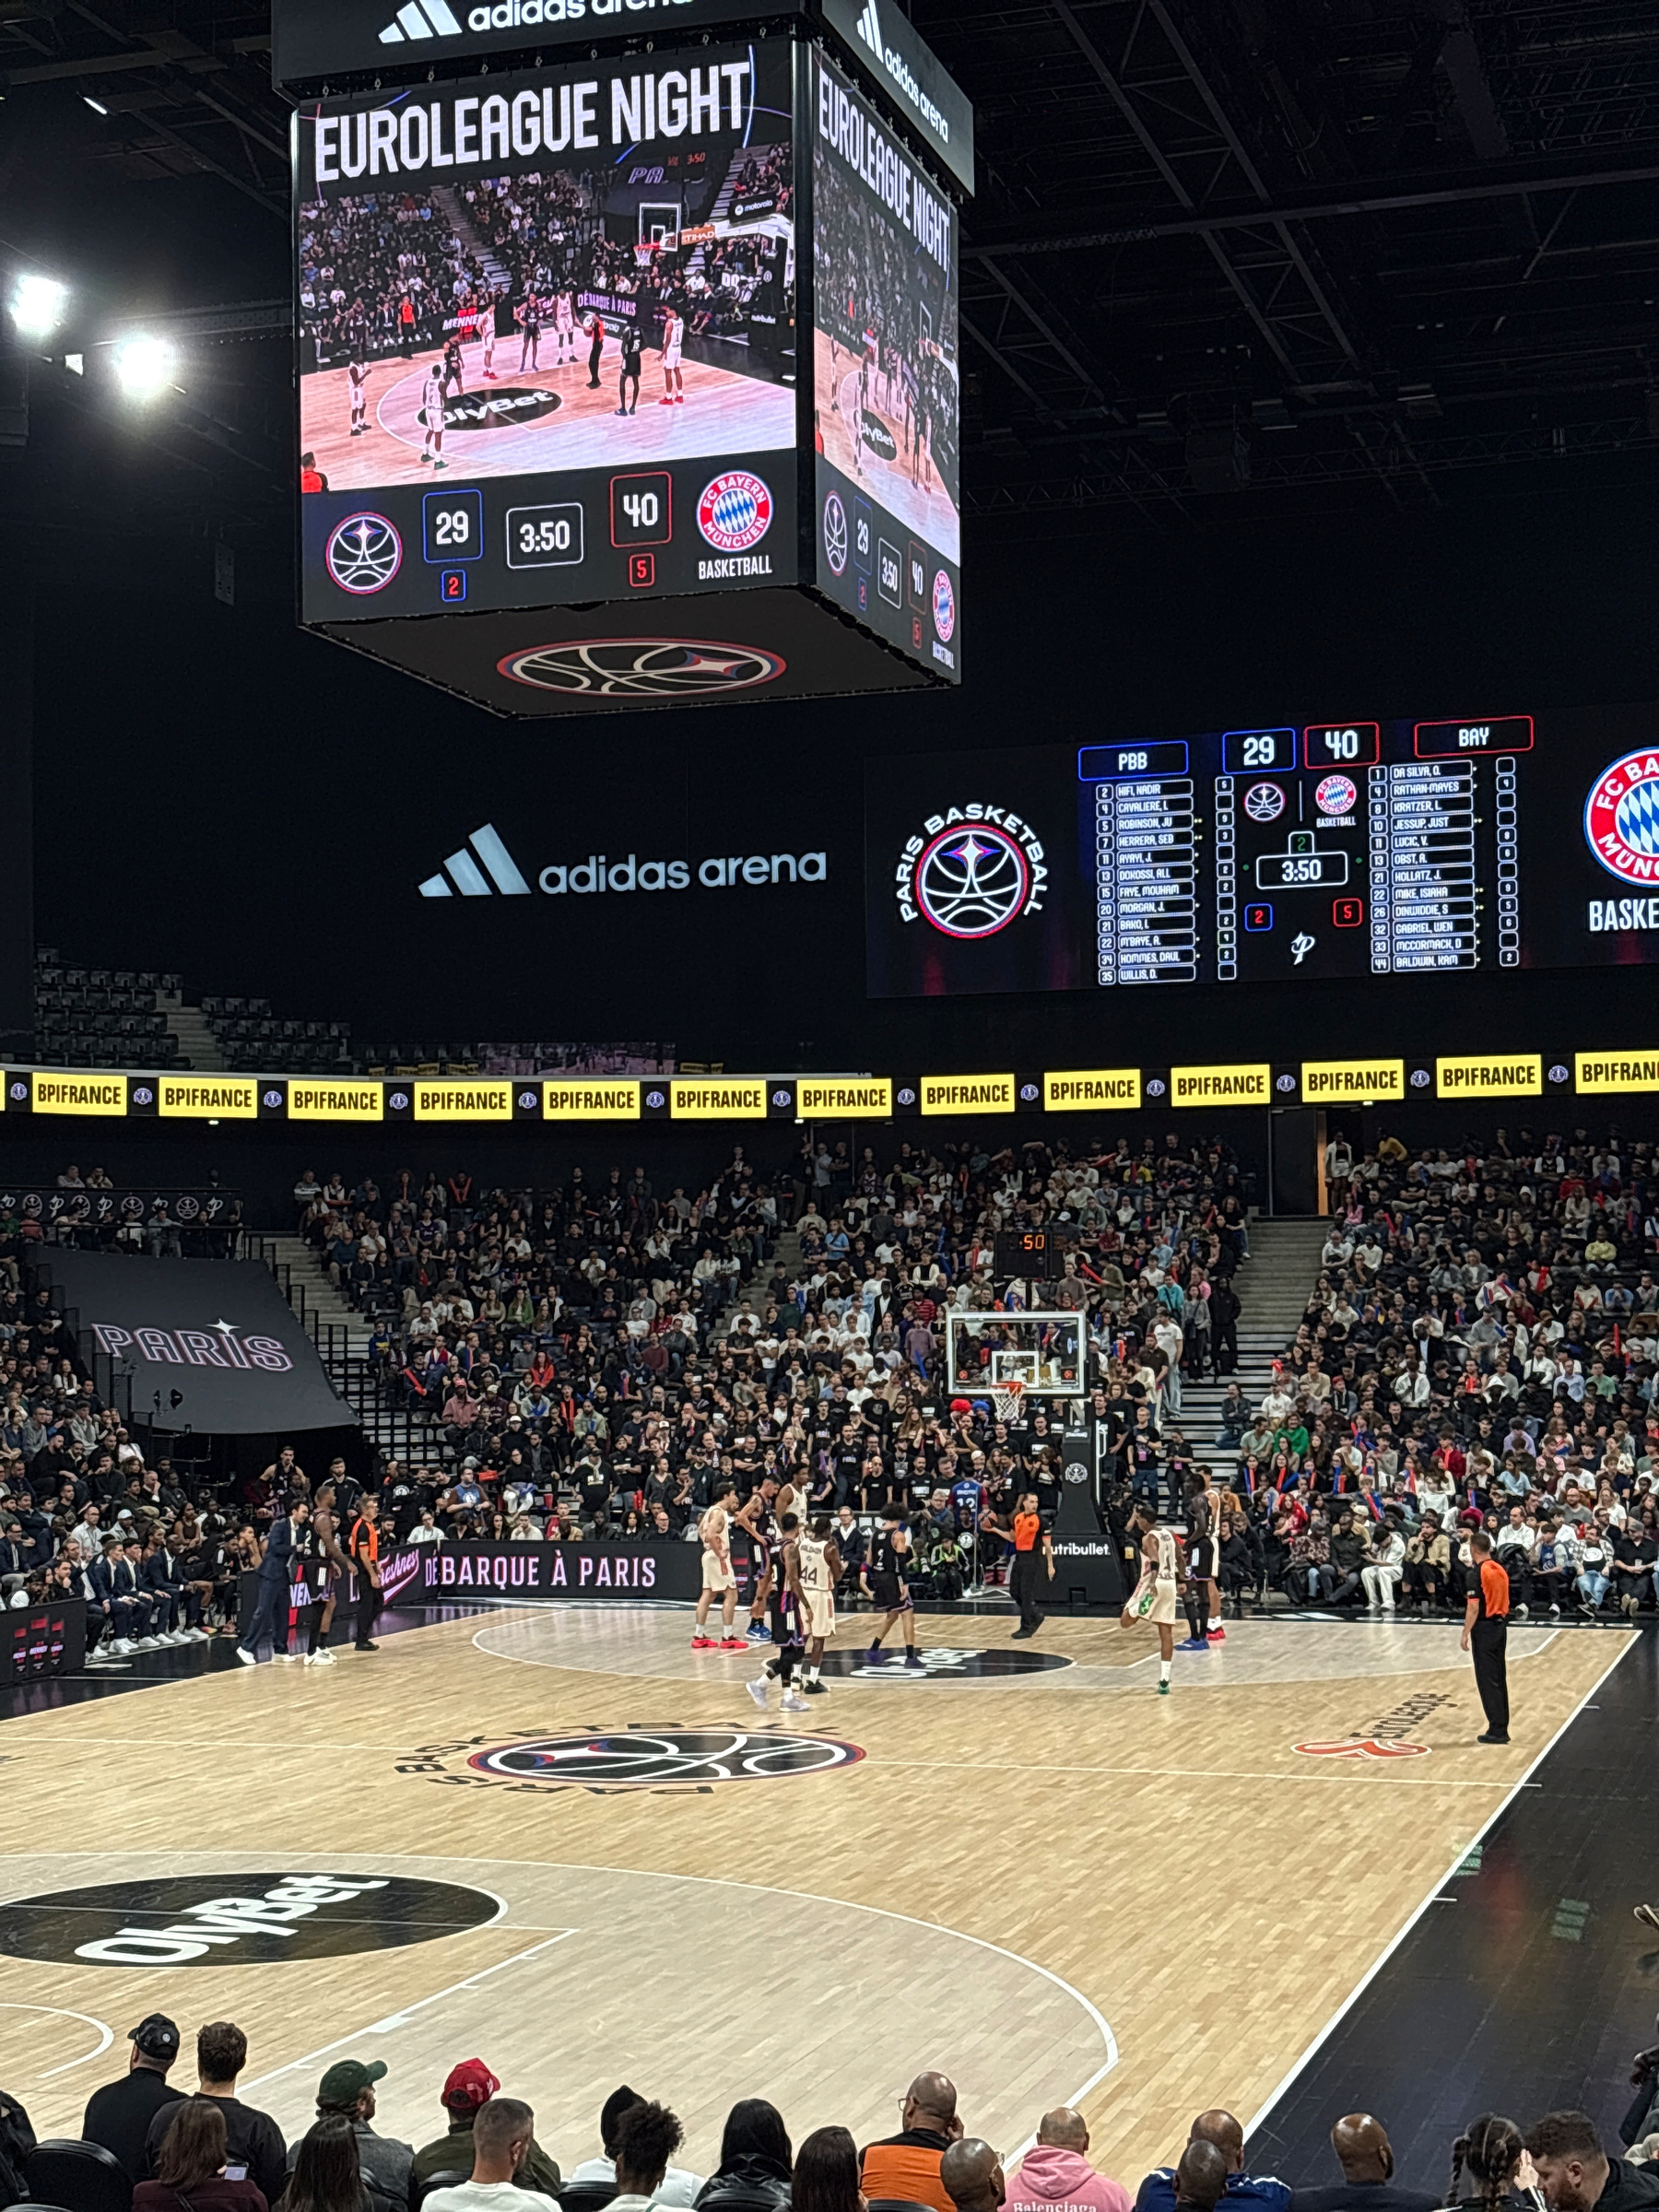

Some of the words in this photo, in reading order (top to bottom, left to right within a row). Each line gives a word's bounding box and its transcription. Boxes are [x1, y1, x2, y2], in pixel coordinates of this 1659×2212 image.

[468, 0, 586, 31] adidas
[885, 47, 919, 108] adidas
[920, 92, 948, 144] arena
[315, 81, 598, 183] EUROLEAGUE
[610, 61, 750, 145] NIGHT
[818, 67, 912, 230] EUROLEAGUE
[913, 175, 949, 272] NIGHT
[617, 300, 637, 315] PARIS
[442, 313, 481, 331] MENNE
[702, 488, 718, 509] FC
[717, 476, 767, 504] BAYERN
[623, 492, 659, 528] 40
[435, 512, 469, 546] 29
[519, 521, 571, 553] 3:50
[857, 518, 869, 555] 29
[882, 556, 898, 592] 3:50
[912, 560, 924, 595] 40
[637, 560, 647, 580] 5
[699, 554, 772, 580] BASKETBALL
[449, 578, 459, 595] 2
[1459, 727, 1489, 747] BAY
[1243, 735, 1275, 766] 29
[1324, 730, 1358, 759] 40
[1118, 752, 1148, 771] PBB
[1595, 778, 1624, 809] FC
[1316, 816, 1356, 828] BASKETBALL
[1373, 820, 1383, 830] 10
[1428, 817, 1449, 828] JUST
[1298, 836, 1306, 852] 2
[896, 835, 924, 922] PARIS
[924, 804, 1048, 915] BASKETBALL
[1374, 855, 1383, 865] 13
[538, 855, 688, 895] adidas
[698, 852, 827, 888] arena
[1101, 871, 1110, 881] 13
[1281, 859, 1322, 882] 3:50
[1374, 873, 1383, 883] 21
[1101, 888, 1110, 898] 15
[1373, 890, 1384, 900] 22
[1100, 904, 1112, 915] 20
[1254, 910, 1263, 924] 2
[1343, 905, 1352, 919] 5
[1373, 908, 1385, 917] 26
[1101, 921, 1111, 932] 21
[1374, 924, 1385, 935] 32
[1101, 938, 1112, 948] 22
[1375, 942, 1386, 952] 33
[1101, 955, 1112, 965] 34
[1374, 959, 1386, 970] 44
[1101, 971, 1112, 982] 35
[38, 1082, 121, 1105] BPIFRANCE
[165, 1086, 252, 1109] BPIFRANCE
[293, 1089, 378, 1111] BPIFRANCE
[420, 1090, 507, 1111] BPIFRANCE
[549, 1090, 634, 1110] BPIFRANCE
[677, 1089, 760, 1110] BPIFRANCE
[803, 1088, 887, 1108] BPIFRANCE
[926, 1084, 1009, 1105] BPIFRANCE
[1050, 1079, 1135, 1101] BPIFRANCE
[1177, 1075, 1265, 1096] BPIFRANCE
[1308, 1069, 1398, 1092] BPIFRANCE
[1442, 1065, 1535, 1088] BPIFRANCE
[91, 1323, 294, 1372] PARIS
[425, 1549, 539, 1590] DÉBARQUE
[550, 1549, 568, 1586] À
[579, 1557, 656, 1587] PARIS
[800, 1565, 818, 1585] 44
[394, 1722, 843, 1774] BASKETBALL
